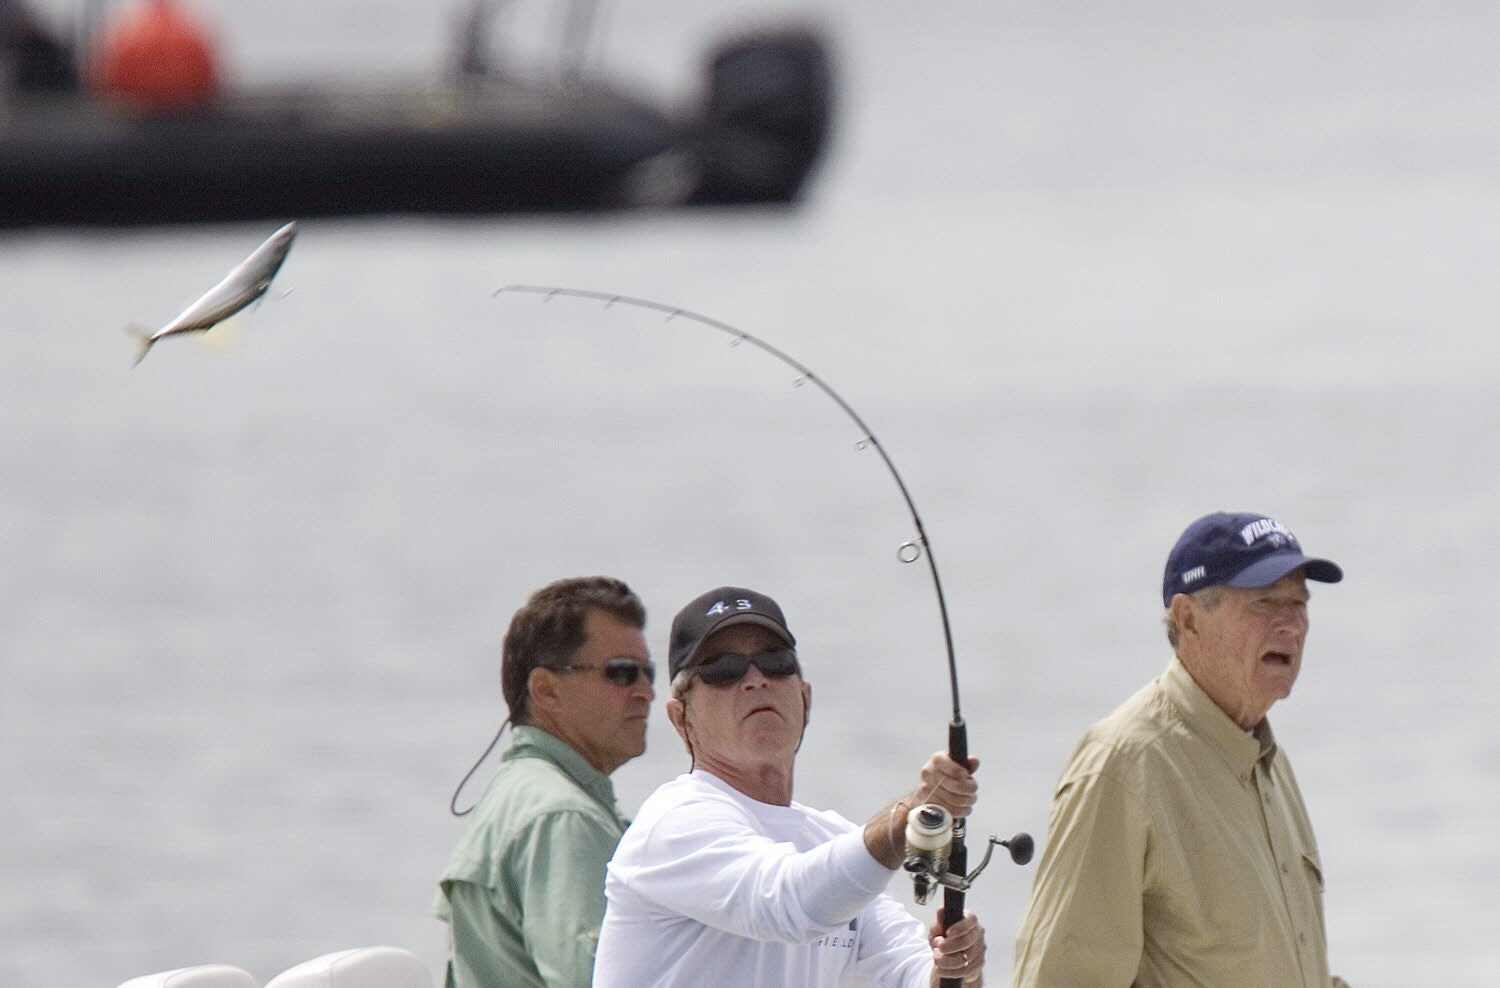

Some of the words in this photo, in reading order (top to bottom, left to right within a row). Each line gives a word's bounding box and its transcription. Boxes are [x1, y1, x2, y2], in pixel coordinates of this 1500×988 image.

[1240, 518, 1296, 546] WILDCA
[1183, 565, 1206, 584] UNH
[706, 599, 752, 616] 43
